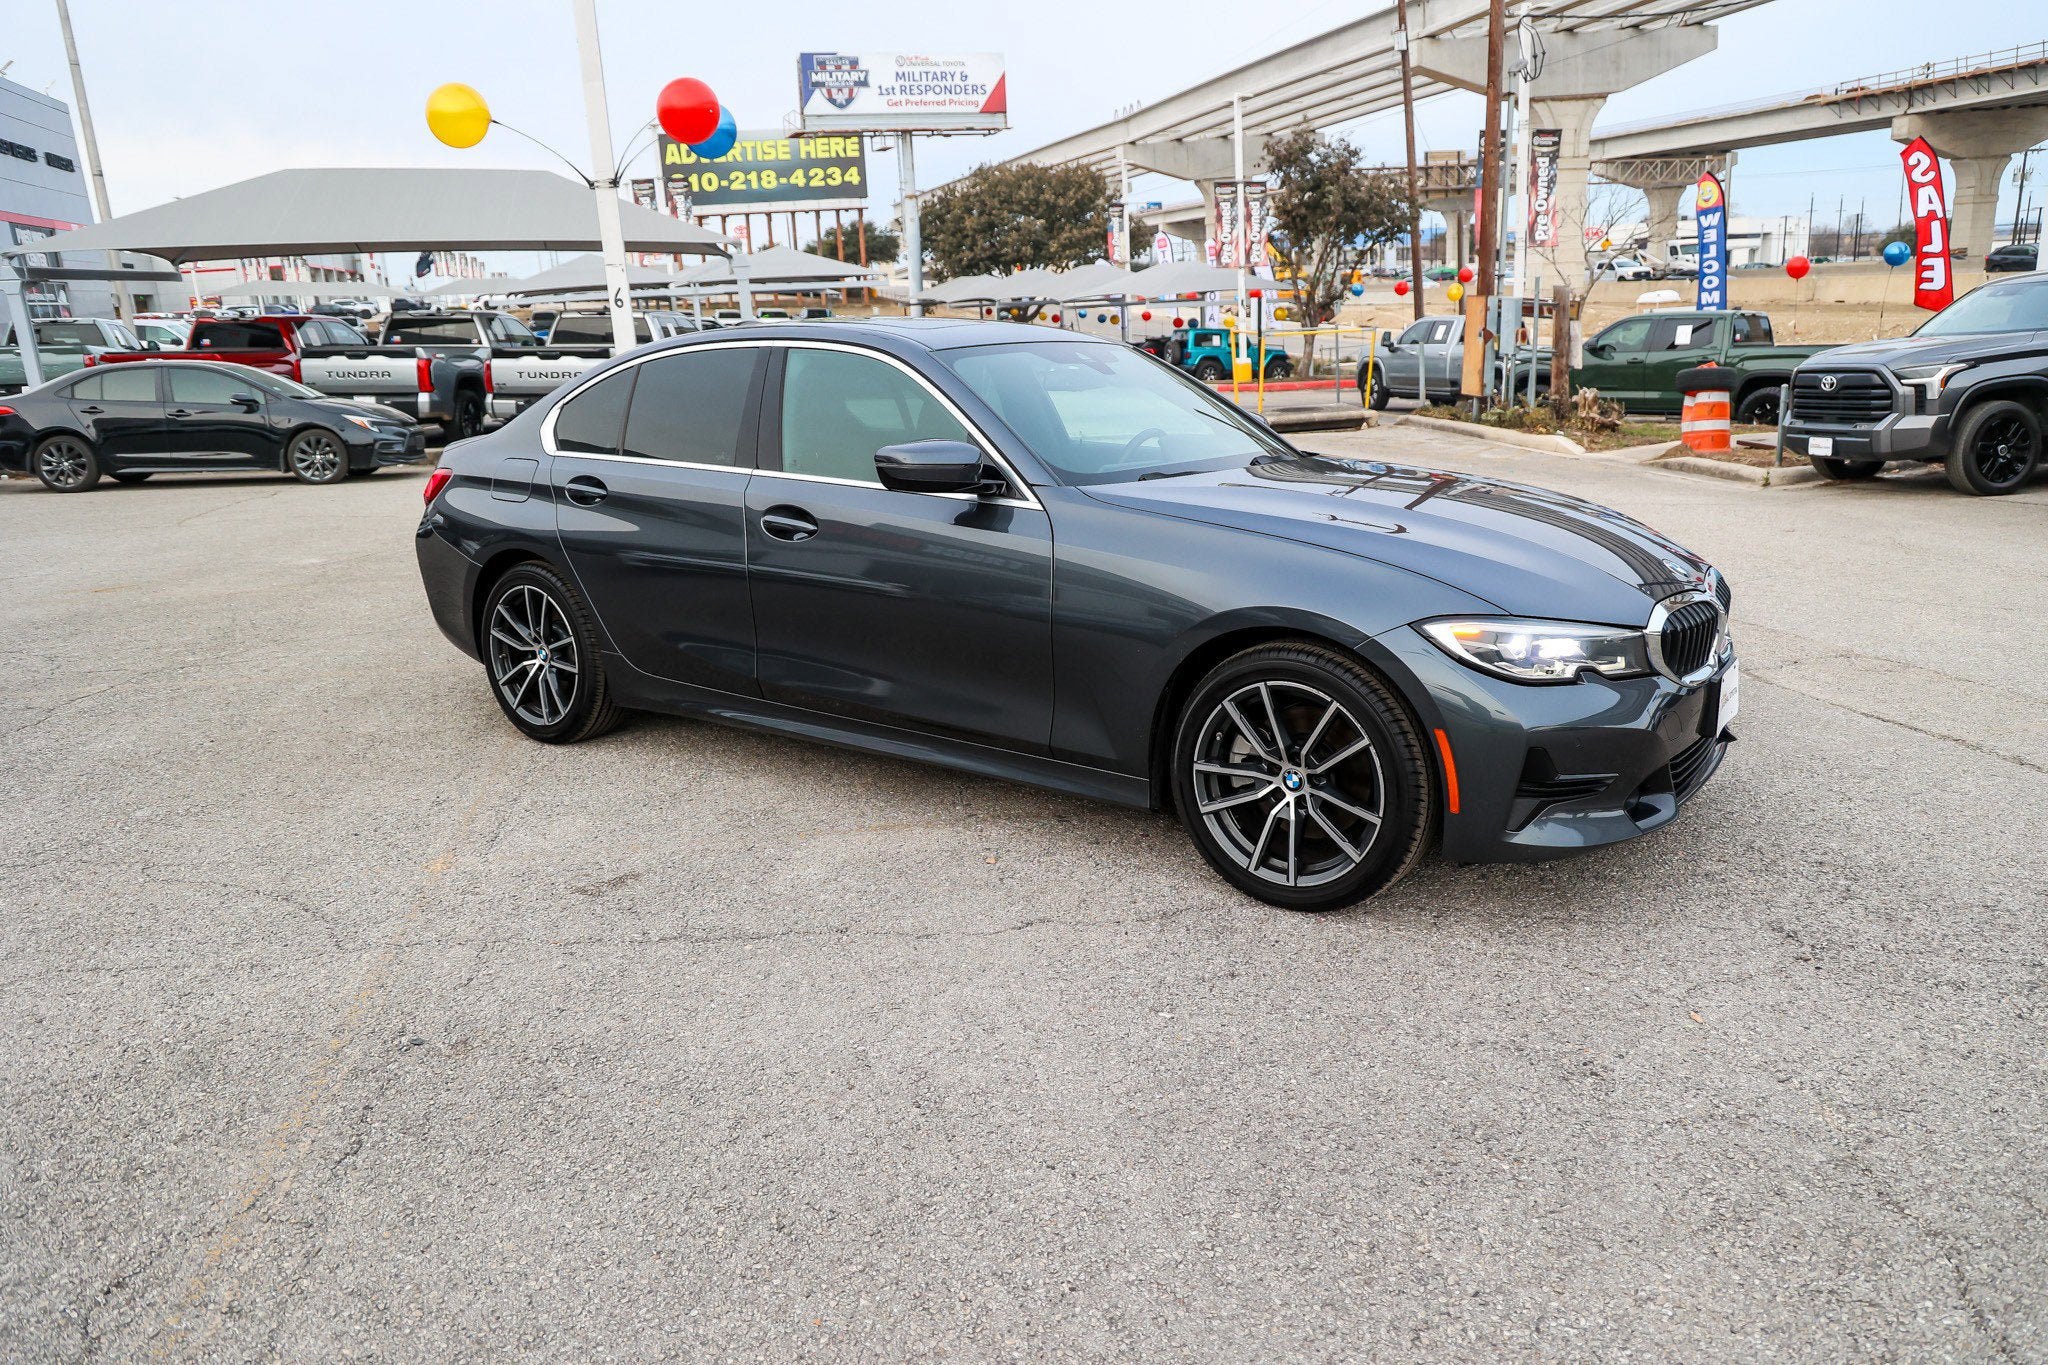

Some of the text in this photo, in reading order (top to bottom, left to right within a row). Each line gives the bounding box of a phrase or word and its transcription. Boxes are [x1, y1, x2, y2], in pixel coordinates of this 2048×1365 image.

[811, 71, 866, 83] MILITARY
[895, 71, 968, 82] MILITARY &
[878, 84, 987, 96] 1st RESPONDERS
[887, 98, 980, 108] Get Preferred Pricing
[665, 136, 860, 165] ADRTISE HERE
[670, 166, 862, 193] 10-218-4234
[1534, 156, 1550, 212] Owned
[1219, 201, 1232, 242] Owned
[1248, 201, 1260, 242] Owned
[1534, 214, 1549, 241] Pre
[1221, 244, 1232, 264] Pre
[1250, 243, 1261, 263] Pre
[614, 287, 624, 309] 6
[325, 371, 392, 380] TUNDRA
